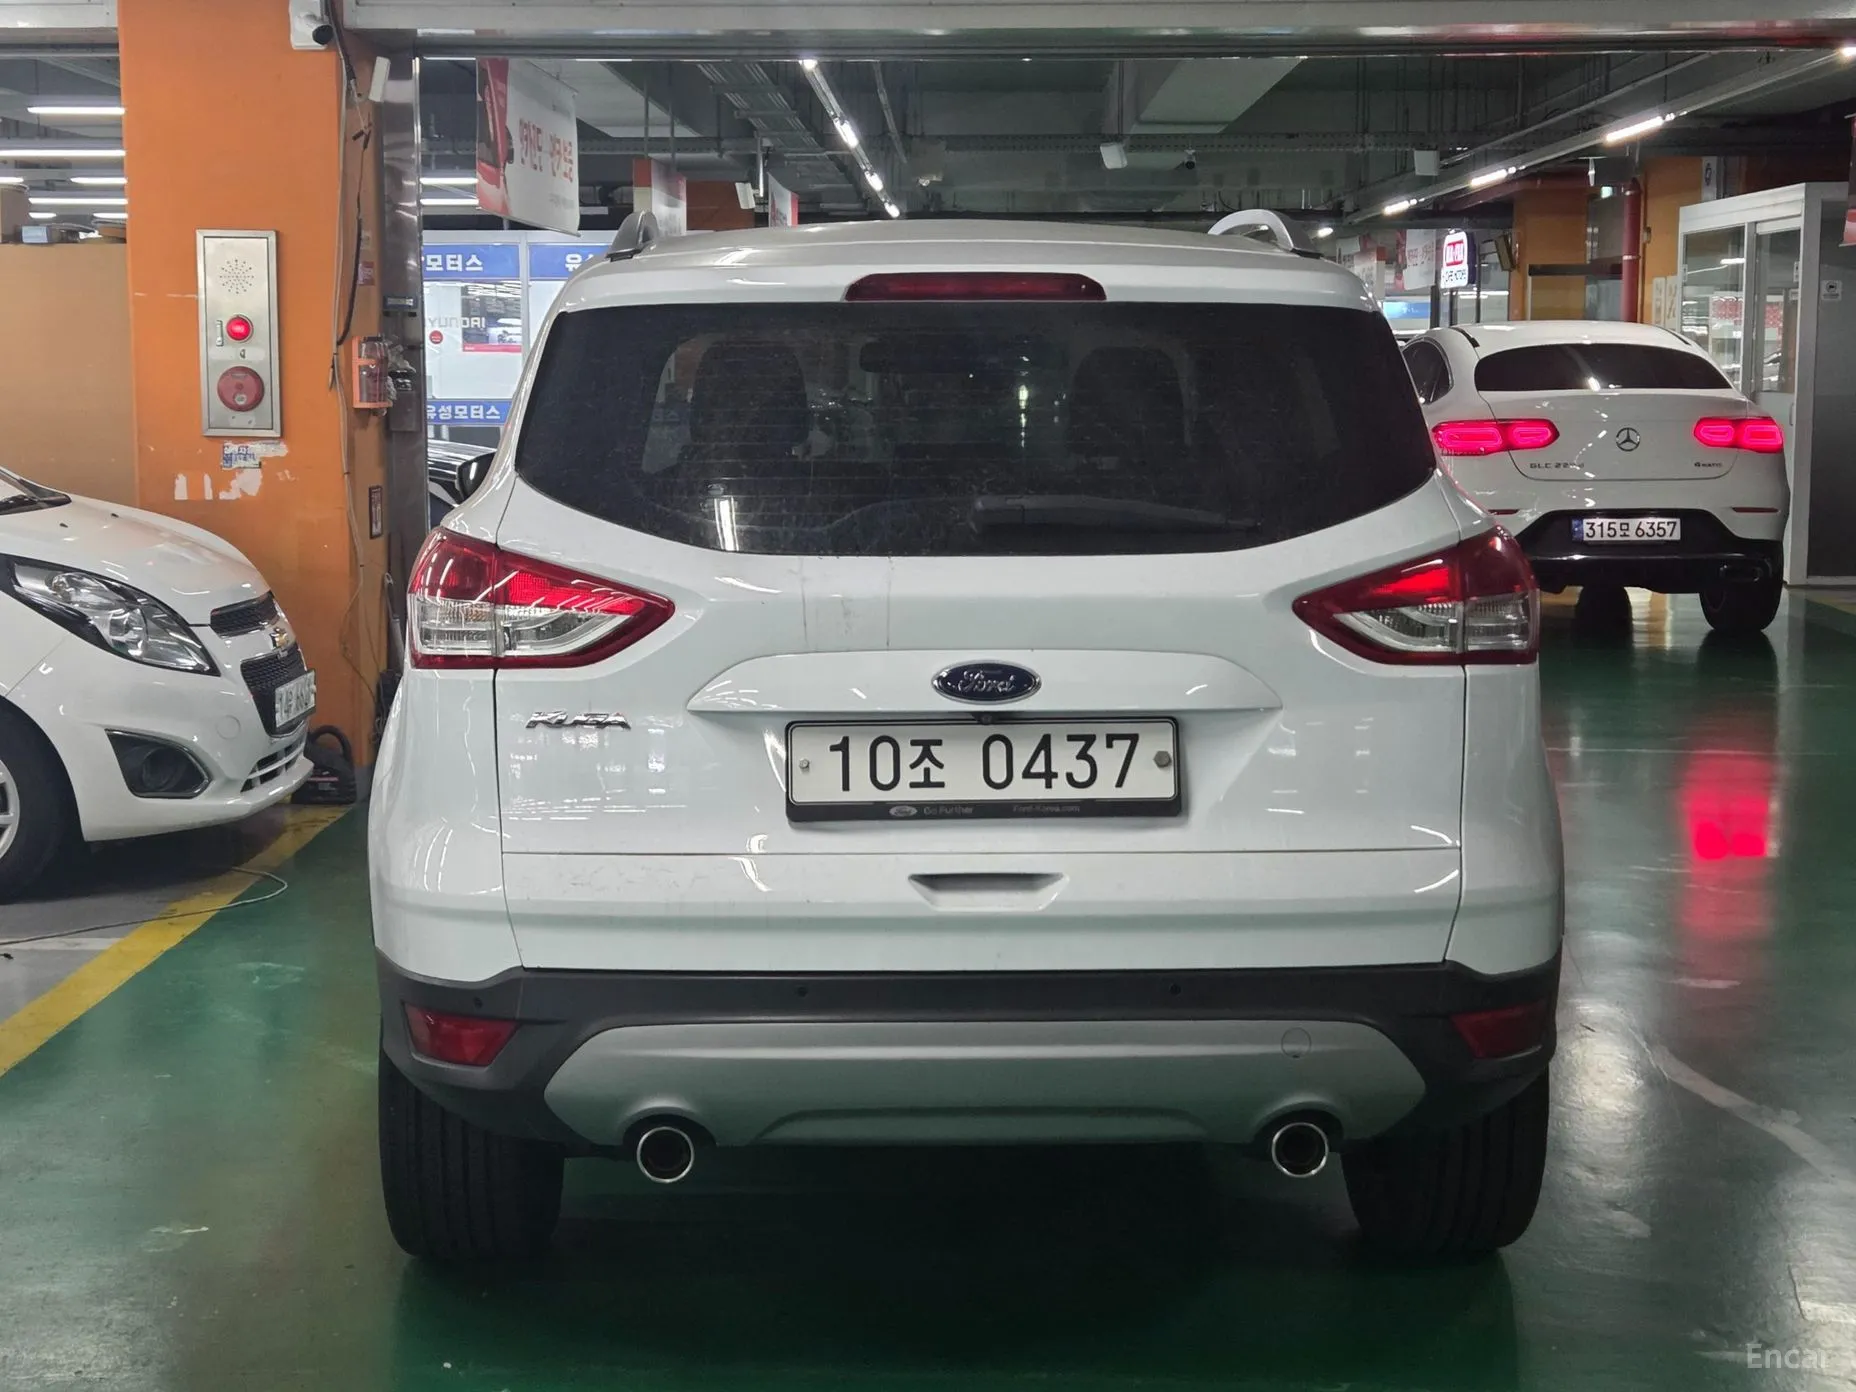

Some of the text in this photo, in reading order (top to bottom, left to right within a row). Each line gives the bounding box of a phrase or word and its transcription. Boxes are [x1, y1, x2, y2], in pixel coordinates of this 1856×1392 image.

[421, 253, 484, 272] 모터스
[1585, 521, 1678, 538] 315모 6357
[828, 732, 1140, 792] 10조 0437
